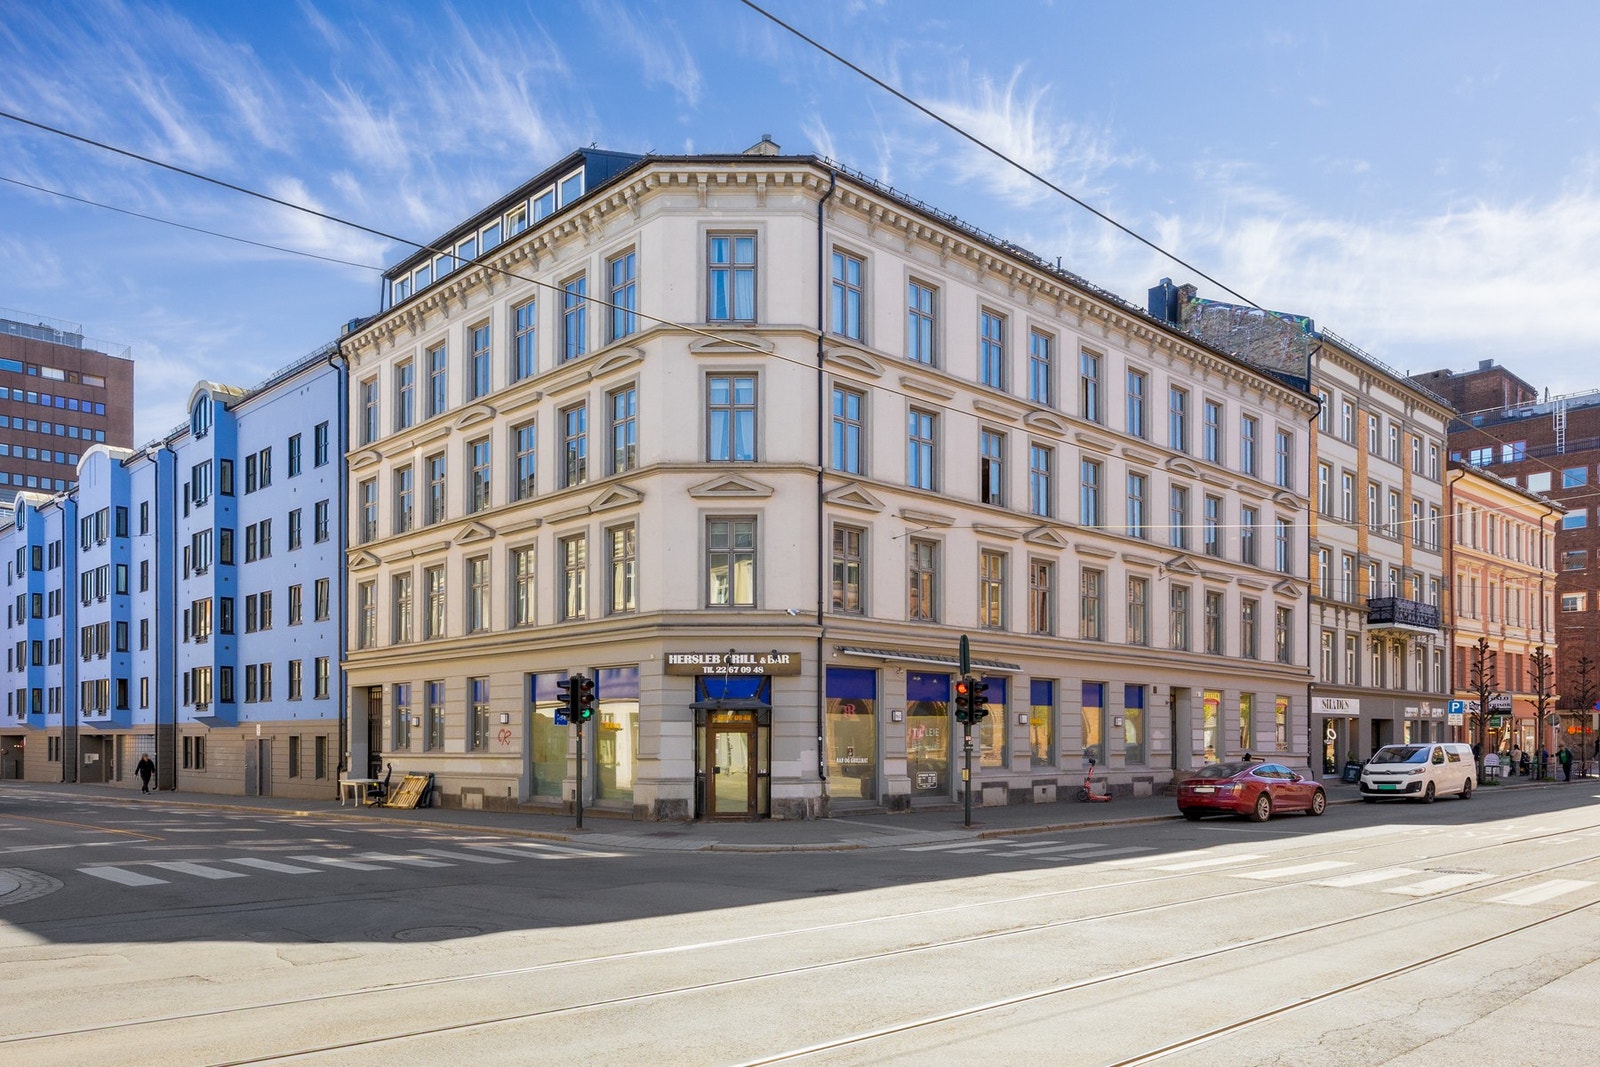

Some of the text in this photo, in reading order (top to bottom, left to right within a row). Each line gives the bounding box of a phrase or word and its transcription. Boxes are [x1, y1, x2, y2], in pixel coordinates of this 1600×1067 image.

[668, 654, 721, 664] HERSLEB
[767, 654, 790, 664] BAR
[715, 666, 727, 674] 22
[728, 666, 739, 674] 67
[740, 666, 752, 674] 09
[752, 666, 764, 674] 48
[1452, 702, 1460, 712] P
